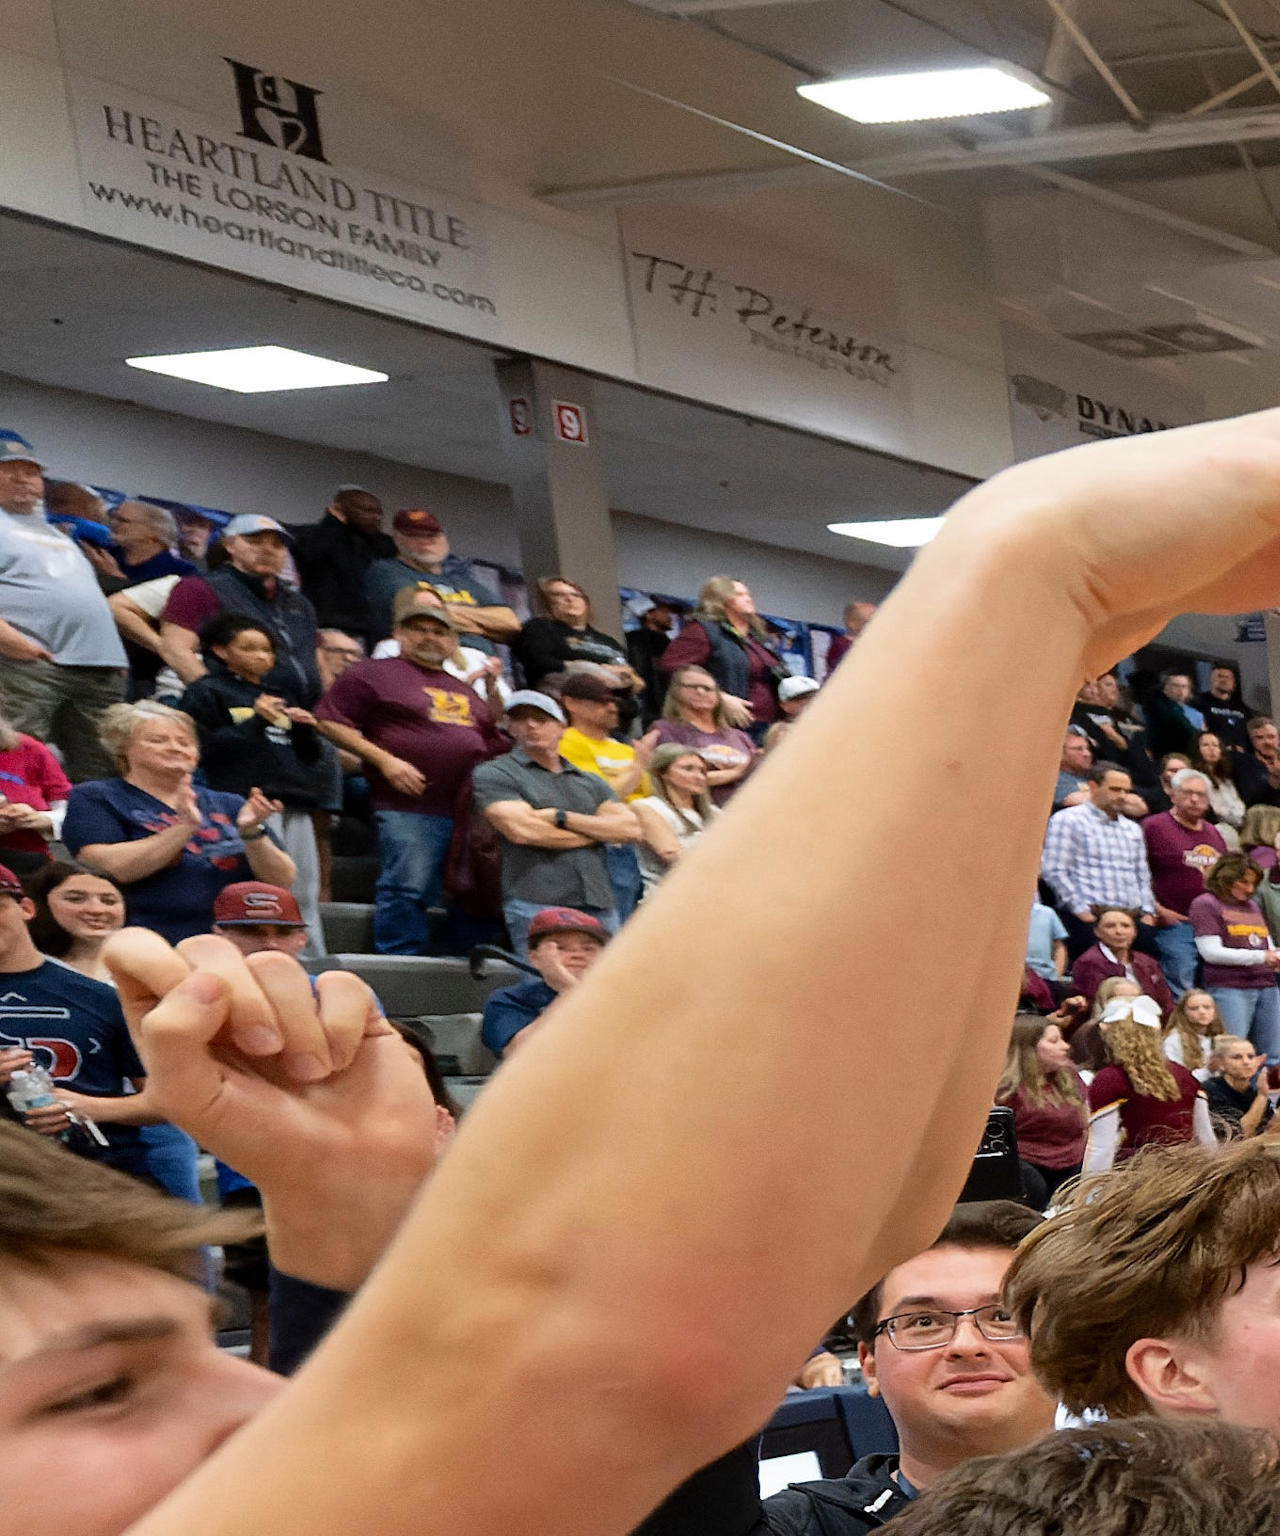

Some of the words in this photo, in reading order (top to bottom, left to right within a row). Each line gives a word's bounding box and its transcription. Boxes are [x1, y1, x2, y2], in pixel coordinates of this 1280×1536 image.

[103, 105, 357, 212] HEARTLAND
[364, 189, 471, 250] TITLE
[146, 161, 202, 196] THE
[213, 184, 340, 239] LORSON
[349, 223, 441, 269] FAMILY
[561, 408, 580, 439] 9
